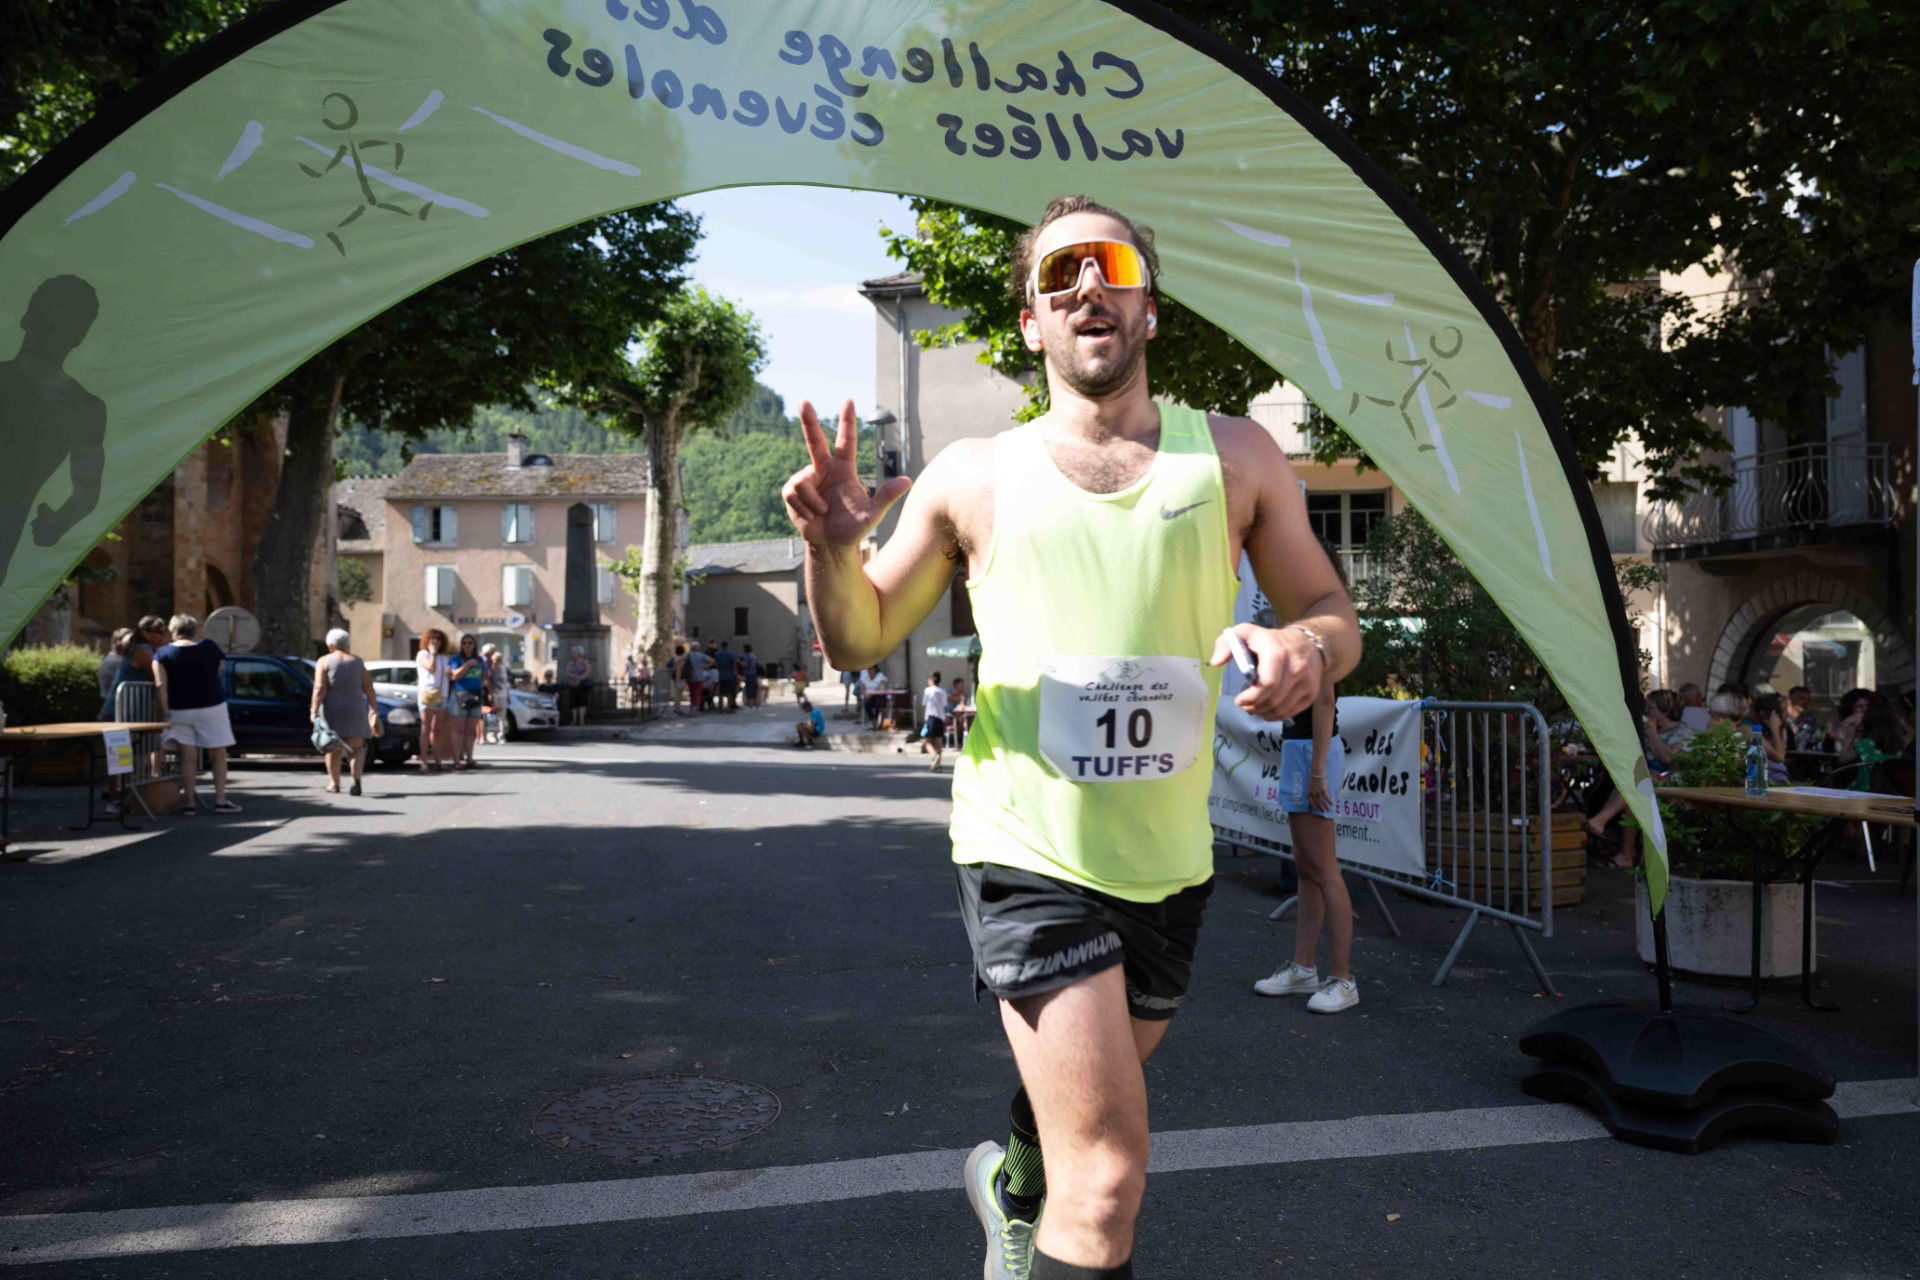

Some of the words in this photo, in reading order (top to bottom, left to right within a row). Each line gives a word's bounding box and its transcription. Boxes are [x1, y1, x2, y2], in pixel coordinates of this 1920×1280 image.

[1079, 692, 1120, 702] vallées
[1085, 681, 1144, 695] Challenge
[1150, 682, 1169, 691] des
[1096, 708, 1153, 749] 10
[1365, 728, 1394, 756] des
[1072, 753, 1174, 777] TUFF'S
[1341, 765, 1409, 795] enoles
[1352, 802, 1381, 819] AOUT
